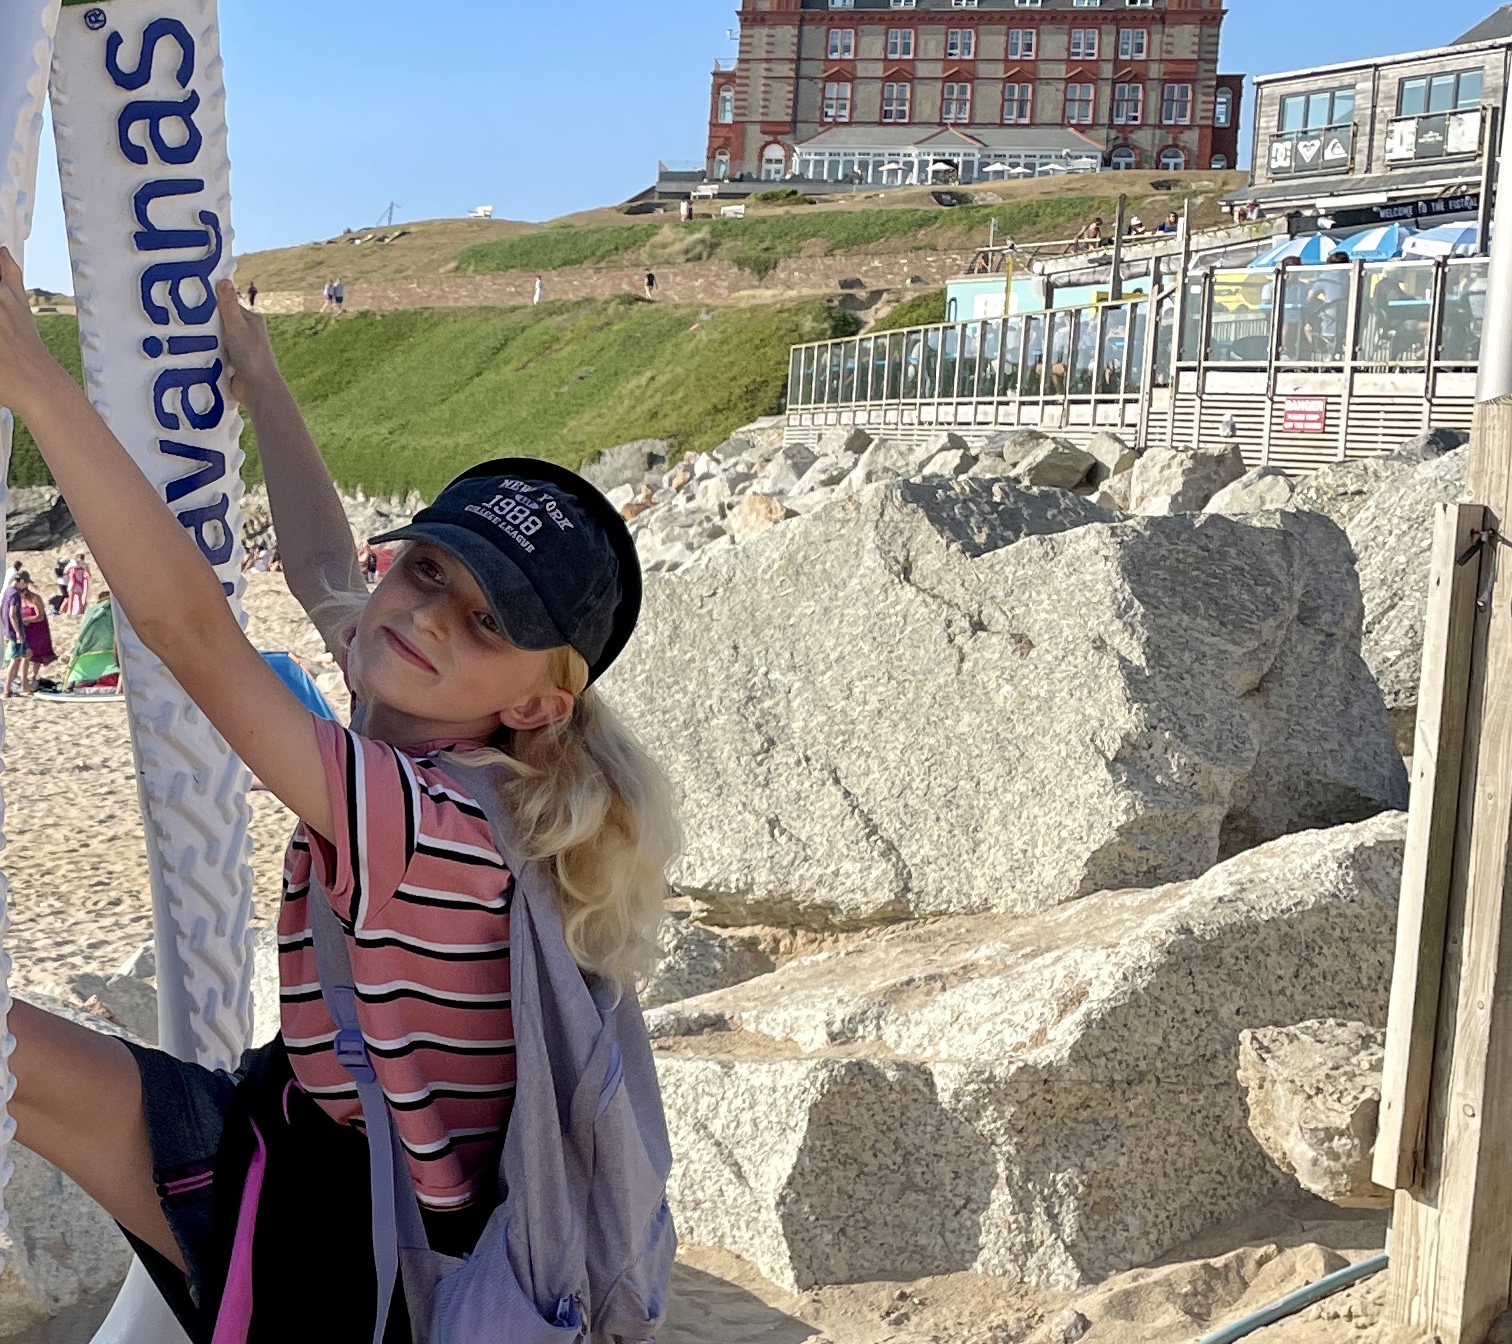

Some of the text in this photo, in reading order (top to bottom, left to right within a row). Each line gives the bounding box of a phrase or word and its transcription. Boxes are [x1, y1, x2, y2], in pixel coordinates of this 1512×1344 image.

[1379, 205, 1414, 218] WELCOME
[1418, 201, 1428, 214] TO
[1431, 200, 1445, 212] THE
[1285, 400, 1324, 412] DANGER
[482, 494, 543, 536] 1988
[498, 479, 538, 493] NEW
[536, 492, 575, 531] YORK
[464, 504, 536, 554] COLLEGE LEAGUE
